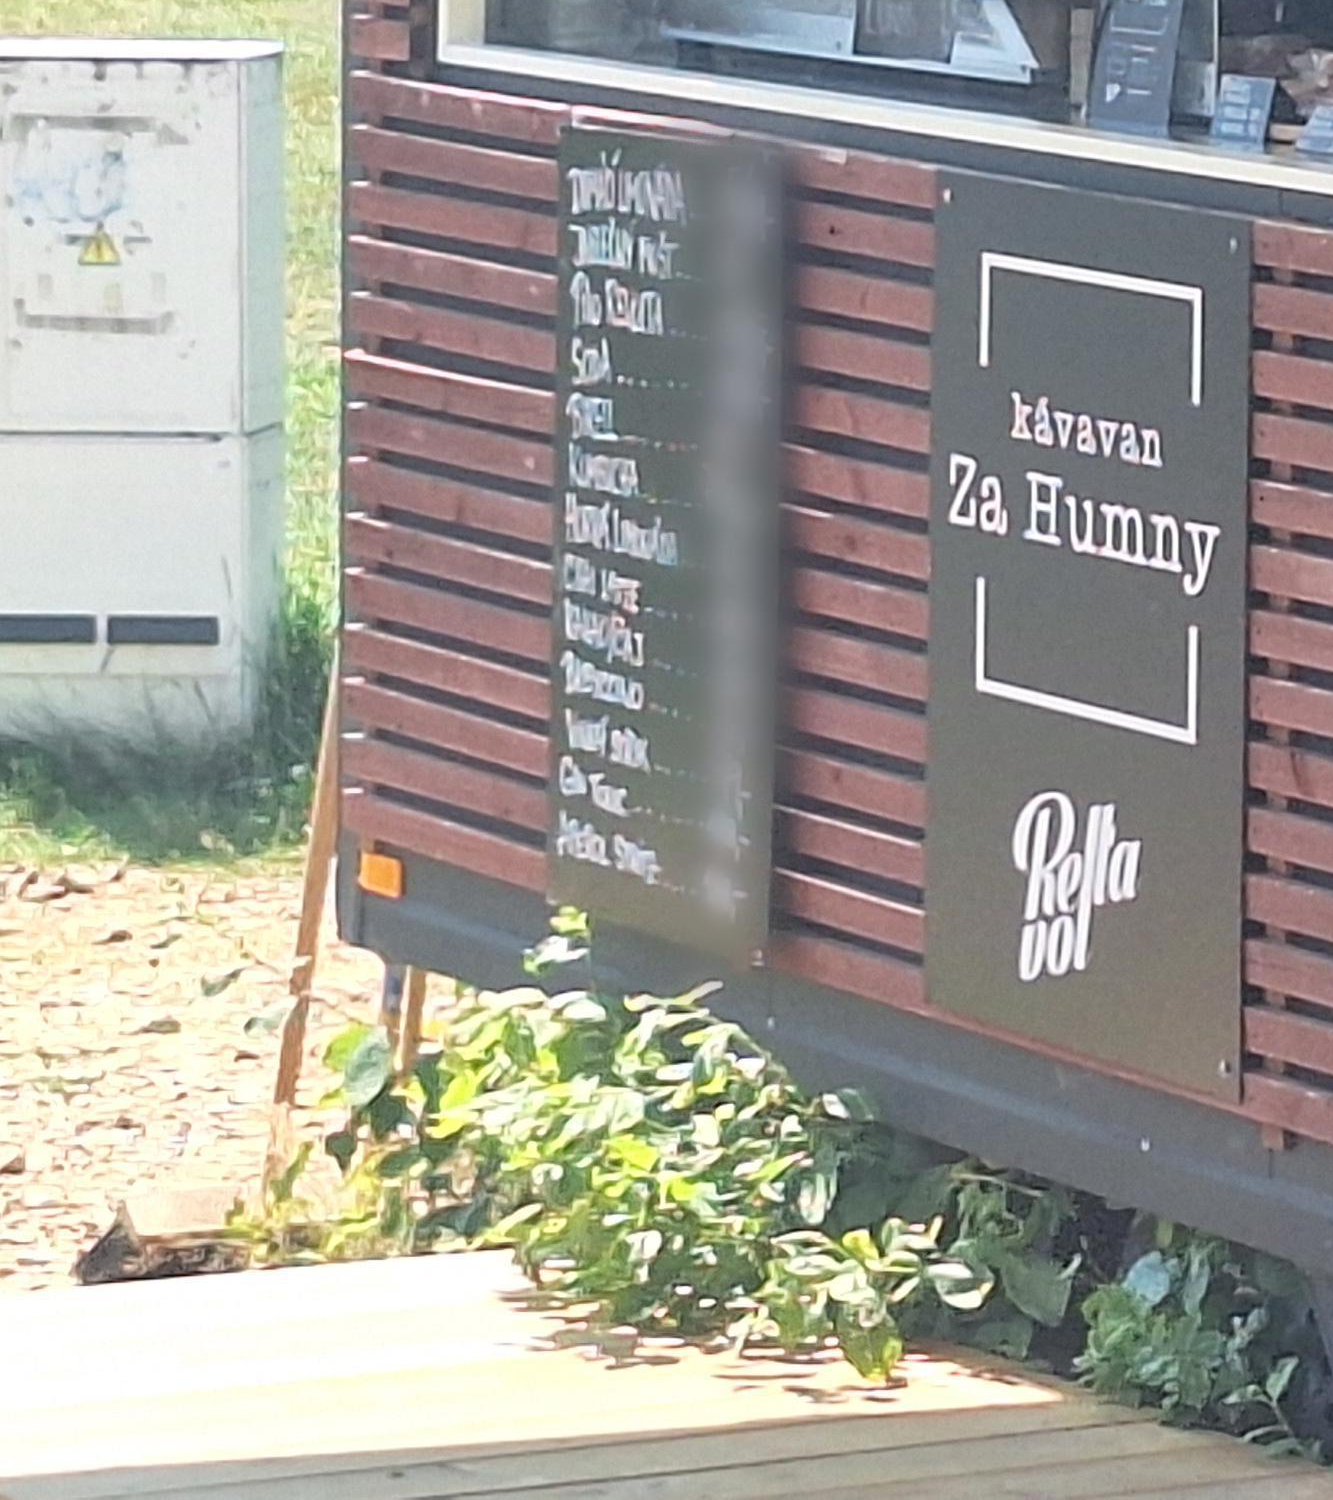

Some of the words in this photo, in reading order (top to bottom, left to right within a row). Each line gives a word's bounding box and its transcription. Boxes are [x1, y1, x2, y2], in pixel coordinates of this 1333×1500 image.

[1010, 391, 1163, 468] kávavan
[949, 452, 1008, 536] Za
[1022, 470, 1221, 596] Humny
